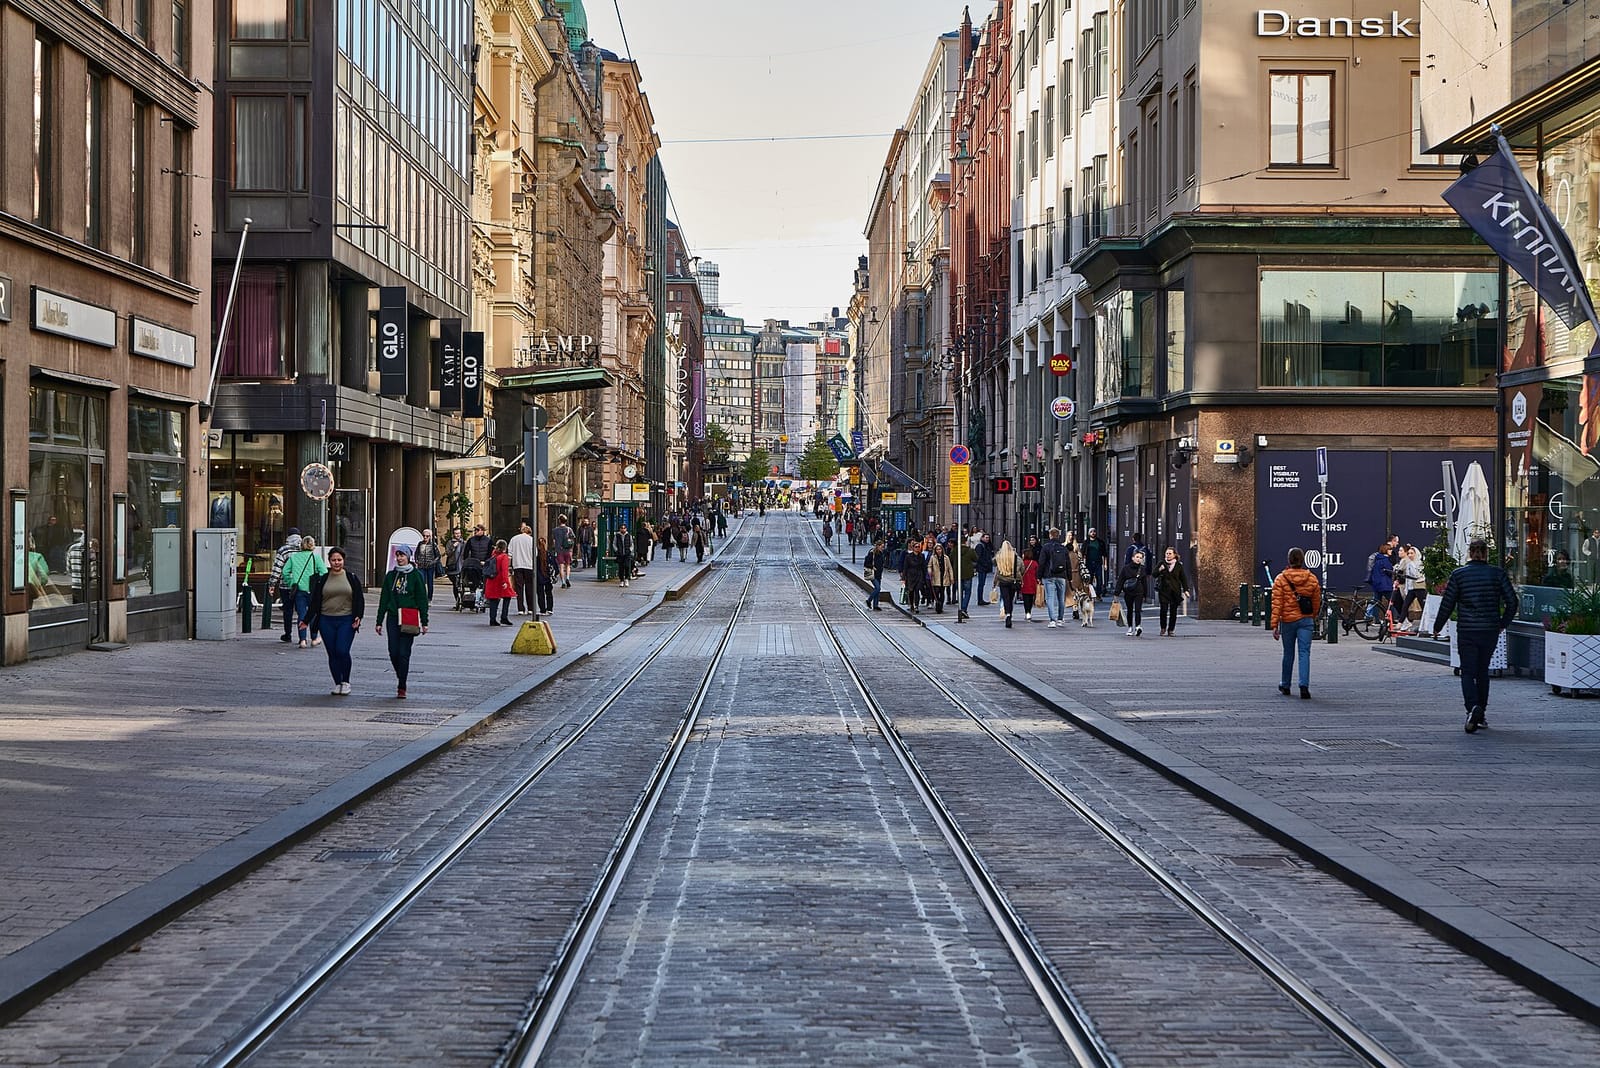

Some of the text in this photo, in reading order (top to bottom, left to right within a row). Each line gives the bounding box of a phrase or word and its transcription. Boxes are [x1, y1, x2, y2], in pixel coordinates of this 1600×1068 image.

[1257, 9, 1420, 37] Dansk
[382, 322, 399, 360] GLO
[1051, 359, 1070, 367] RAX
[464, 355, 478, 389] GLO
[997, 479, 1010, 491] D
[1023, 475, 1037, 489] D
[1302, 523, 1320, 531] THE
